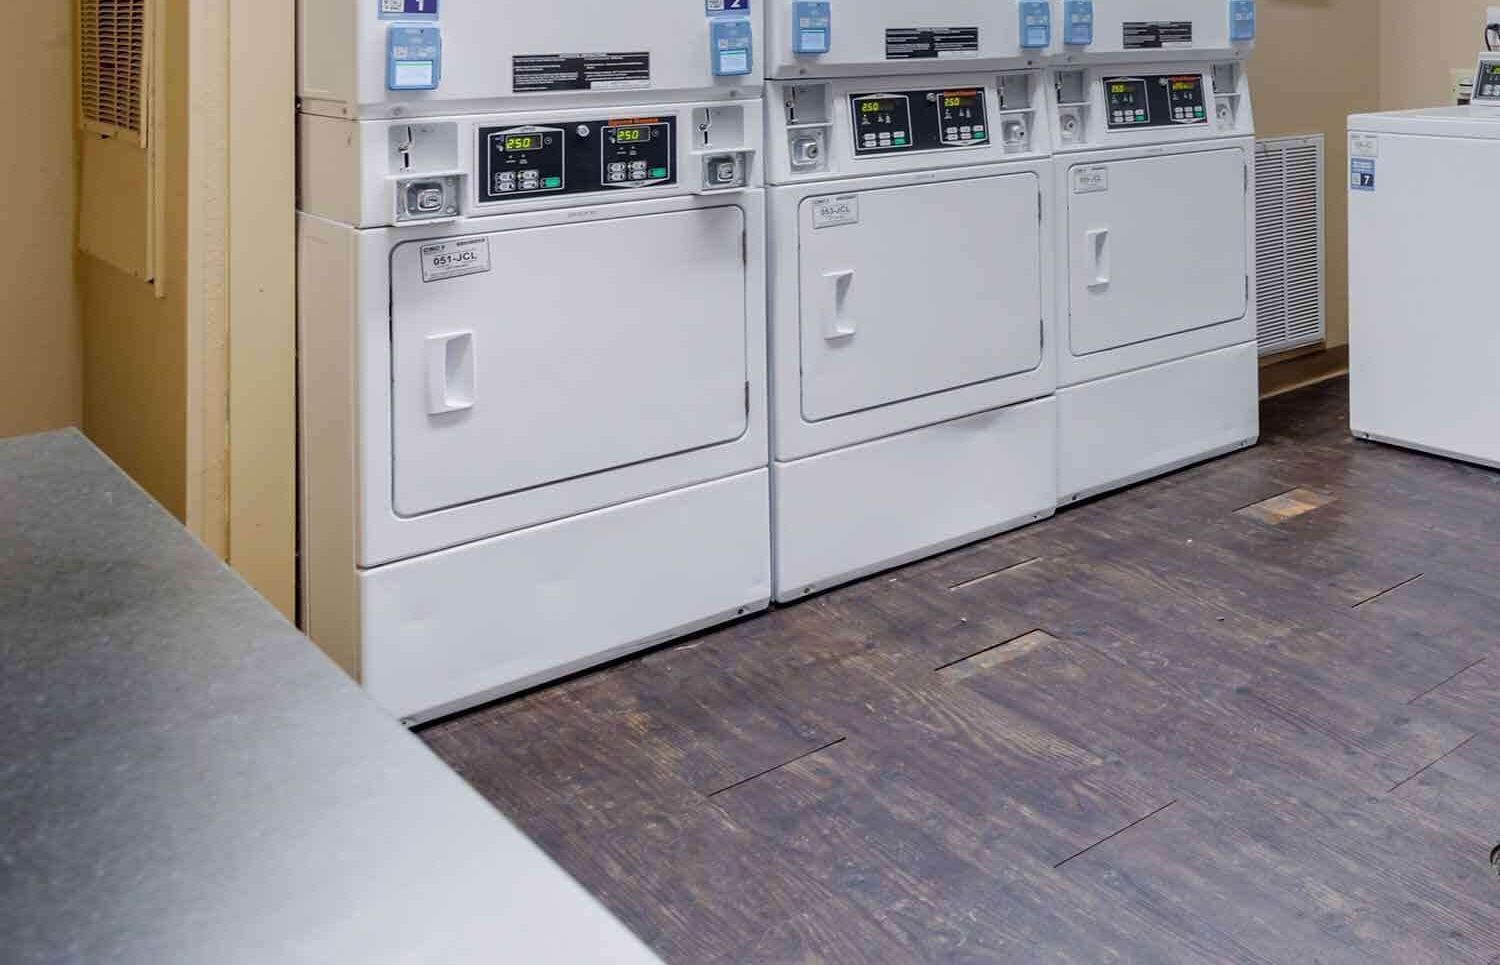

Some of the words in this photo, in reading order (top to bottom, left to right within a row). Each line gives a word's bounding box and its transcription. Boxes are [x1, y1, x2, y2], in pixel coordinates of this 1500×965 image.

[862, 102, 879, 112] 250
[617, 130, 639, 141] 250
[505, 137, 531, 149] 250
[1363, 174, 1370, 185] 7
[433, 251, 478, 266] 051-JCL
